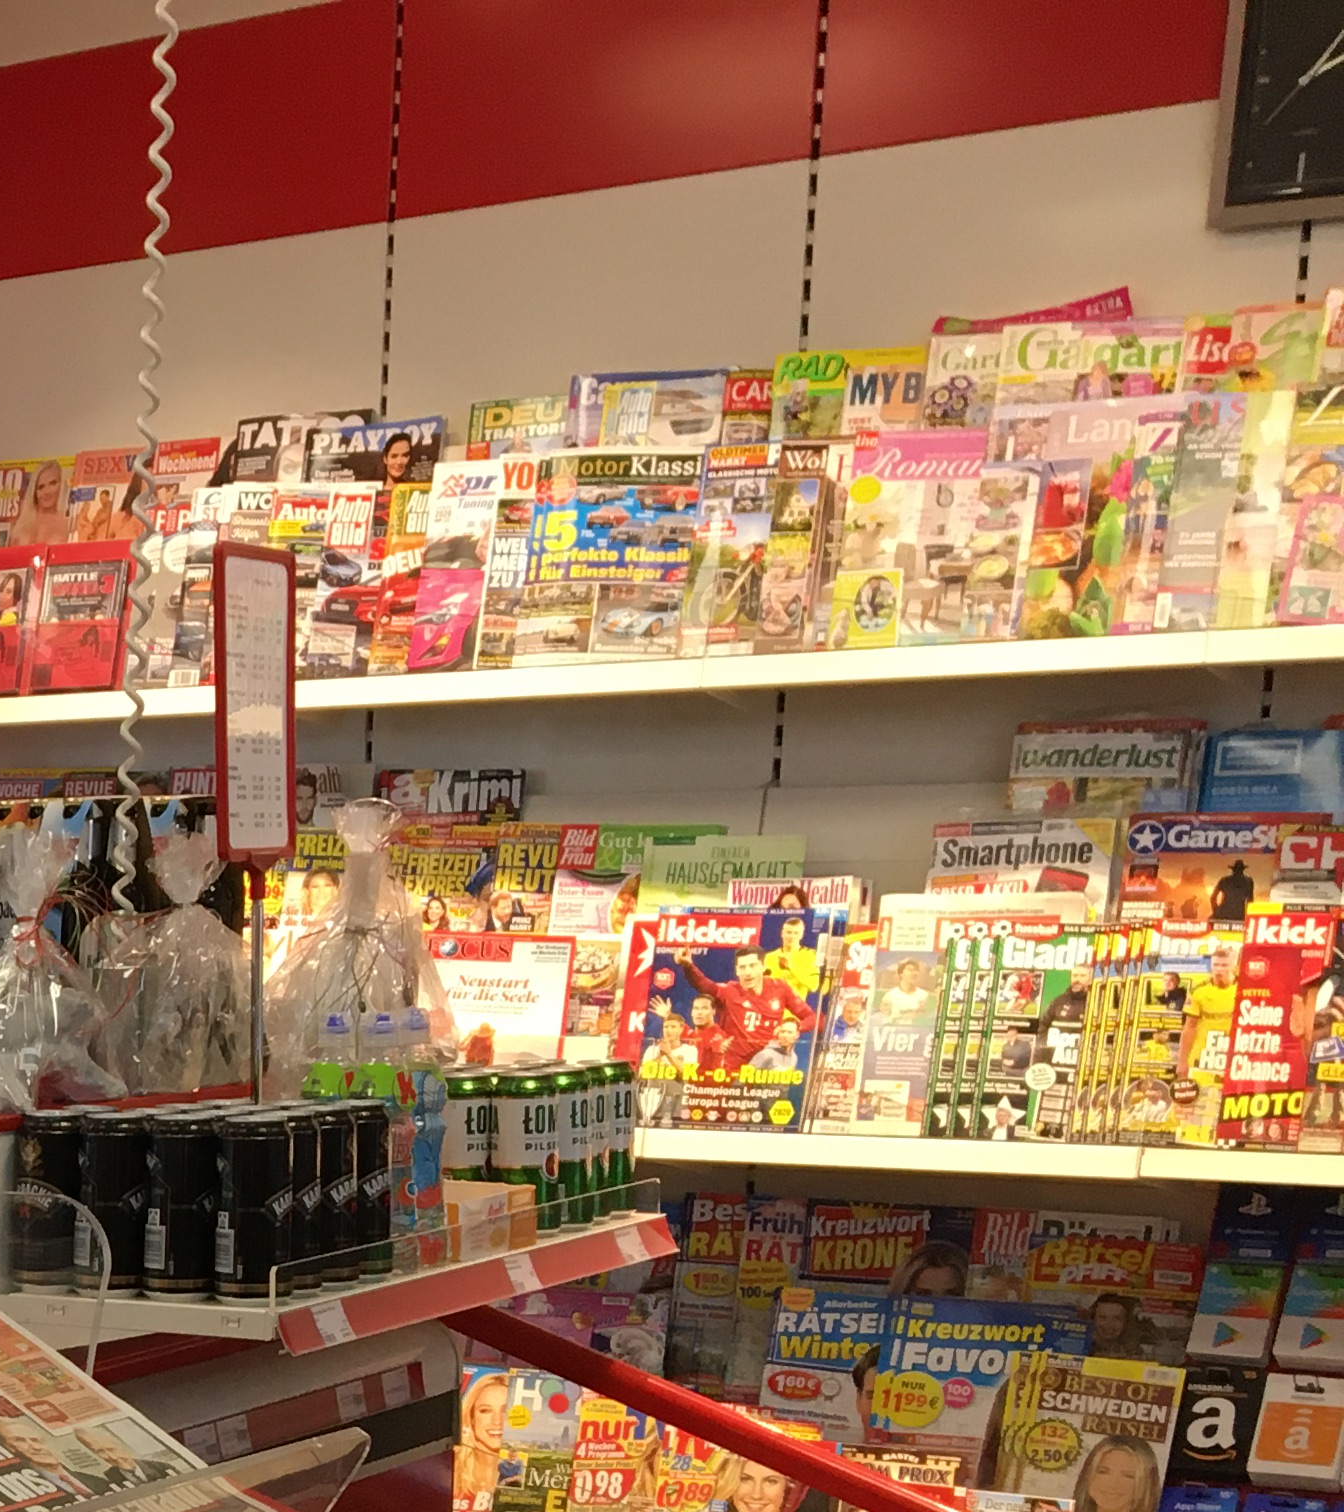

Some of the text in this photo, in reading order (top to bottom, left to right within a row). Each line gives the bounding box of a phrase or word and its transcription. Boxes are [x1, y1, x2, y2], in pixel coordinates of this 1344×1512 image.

[158, 452, 216, 473] Wochenend
[332, 496, 370, 523] Auto
[329, 522, 366, 545] Bild
[545, 510, 579, 551] 5
[541, 547, 619, 565] perfekte
[570, 562, 664, 583] Einsteiger
[1021, 743, 1179, 770] wanderlust
[562, 827, 597, 849] Bild
[561, 846, 595, 868] Frau
[941, 836, 1094, 869] Smartphone
[670, 917, 758, 945] kicker
[458, 974, 530, 990] Neustart
[472, 987, 540, 1004] die Seele
[1238, 1000, 1284, 1027] Seine
[872, 1028, 919, 1053] Vier
[1234, 1028, 1280, 1053] letzte
[642, 1060, 804, 1085] Die K.-o.-Runde
[1230, 1054, 1290, 1083] Chance
[681, 1095, 760, 1109] Europa League
[683, 1084, 781, 1099] Champions League
[811, 1212, 931, 1237] Kreuzwort
[908, 1319, 1046, 1343] Kreuzwort
[901, 1381, 926, 1391] NUR
[947, 1384, 971, 1396] 100
[1064, 1376, 1160, 1401] BEST OF
[1041, 1390, 1168, 1423] SCHWEDEN
[580, 1416, 636, 1441] nur
[1040, 1424, 1068, 1439] 132
[1, 1464, 60, 1505] uns
